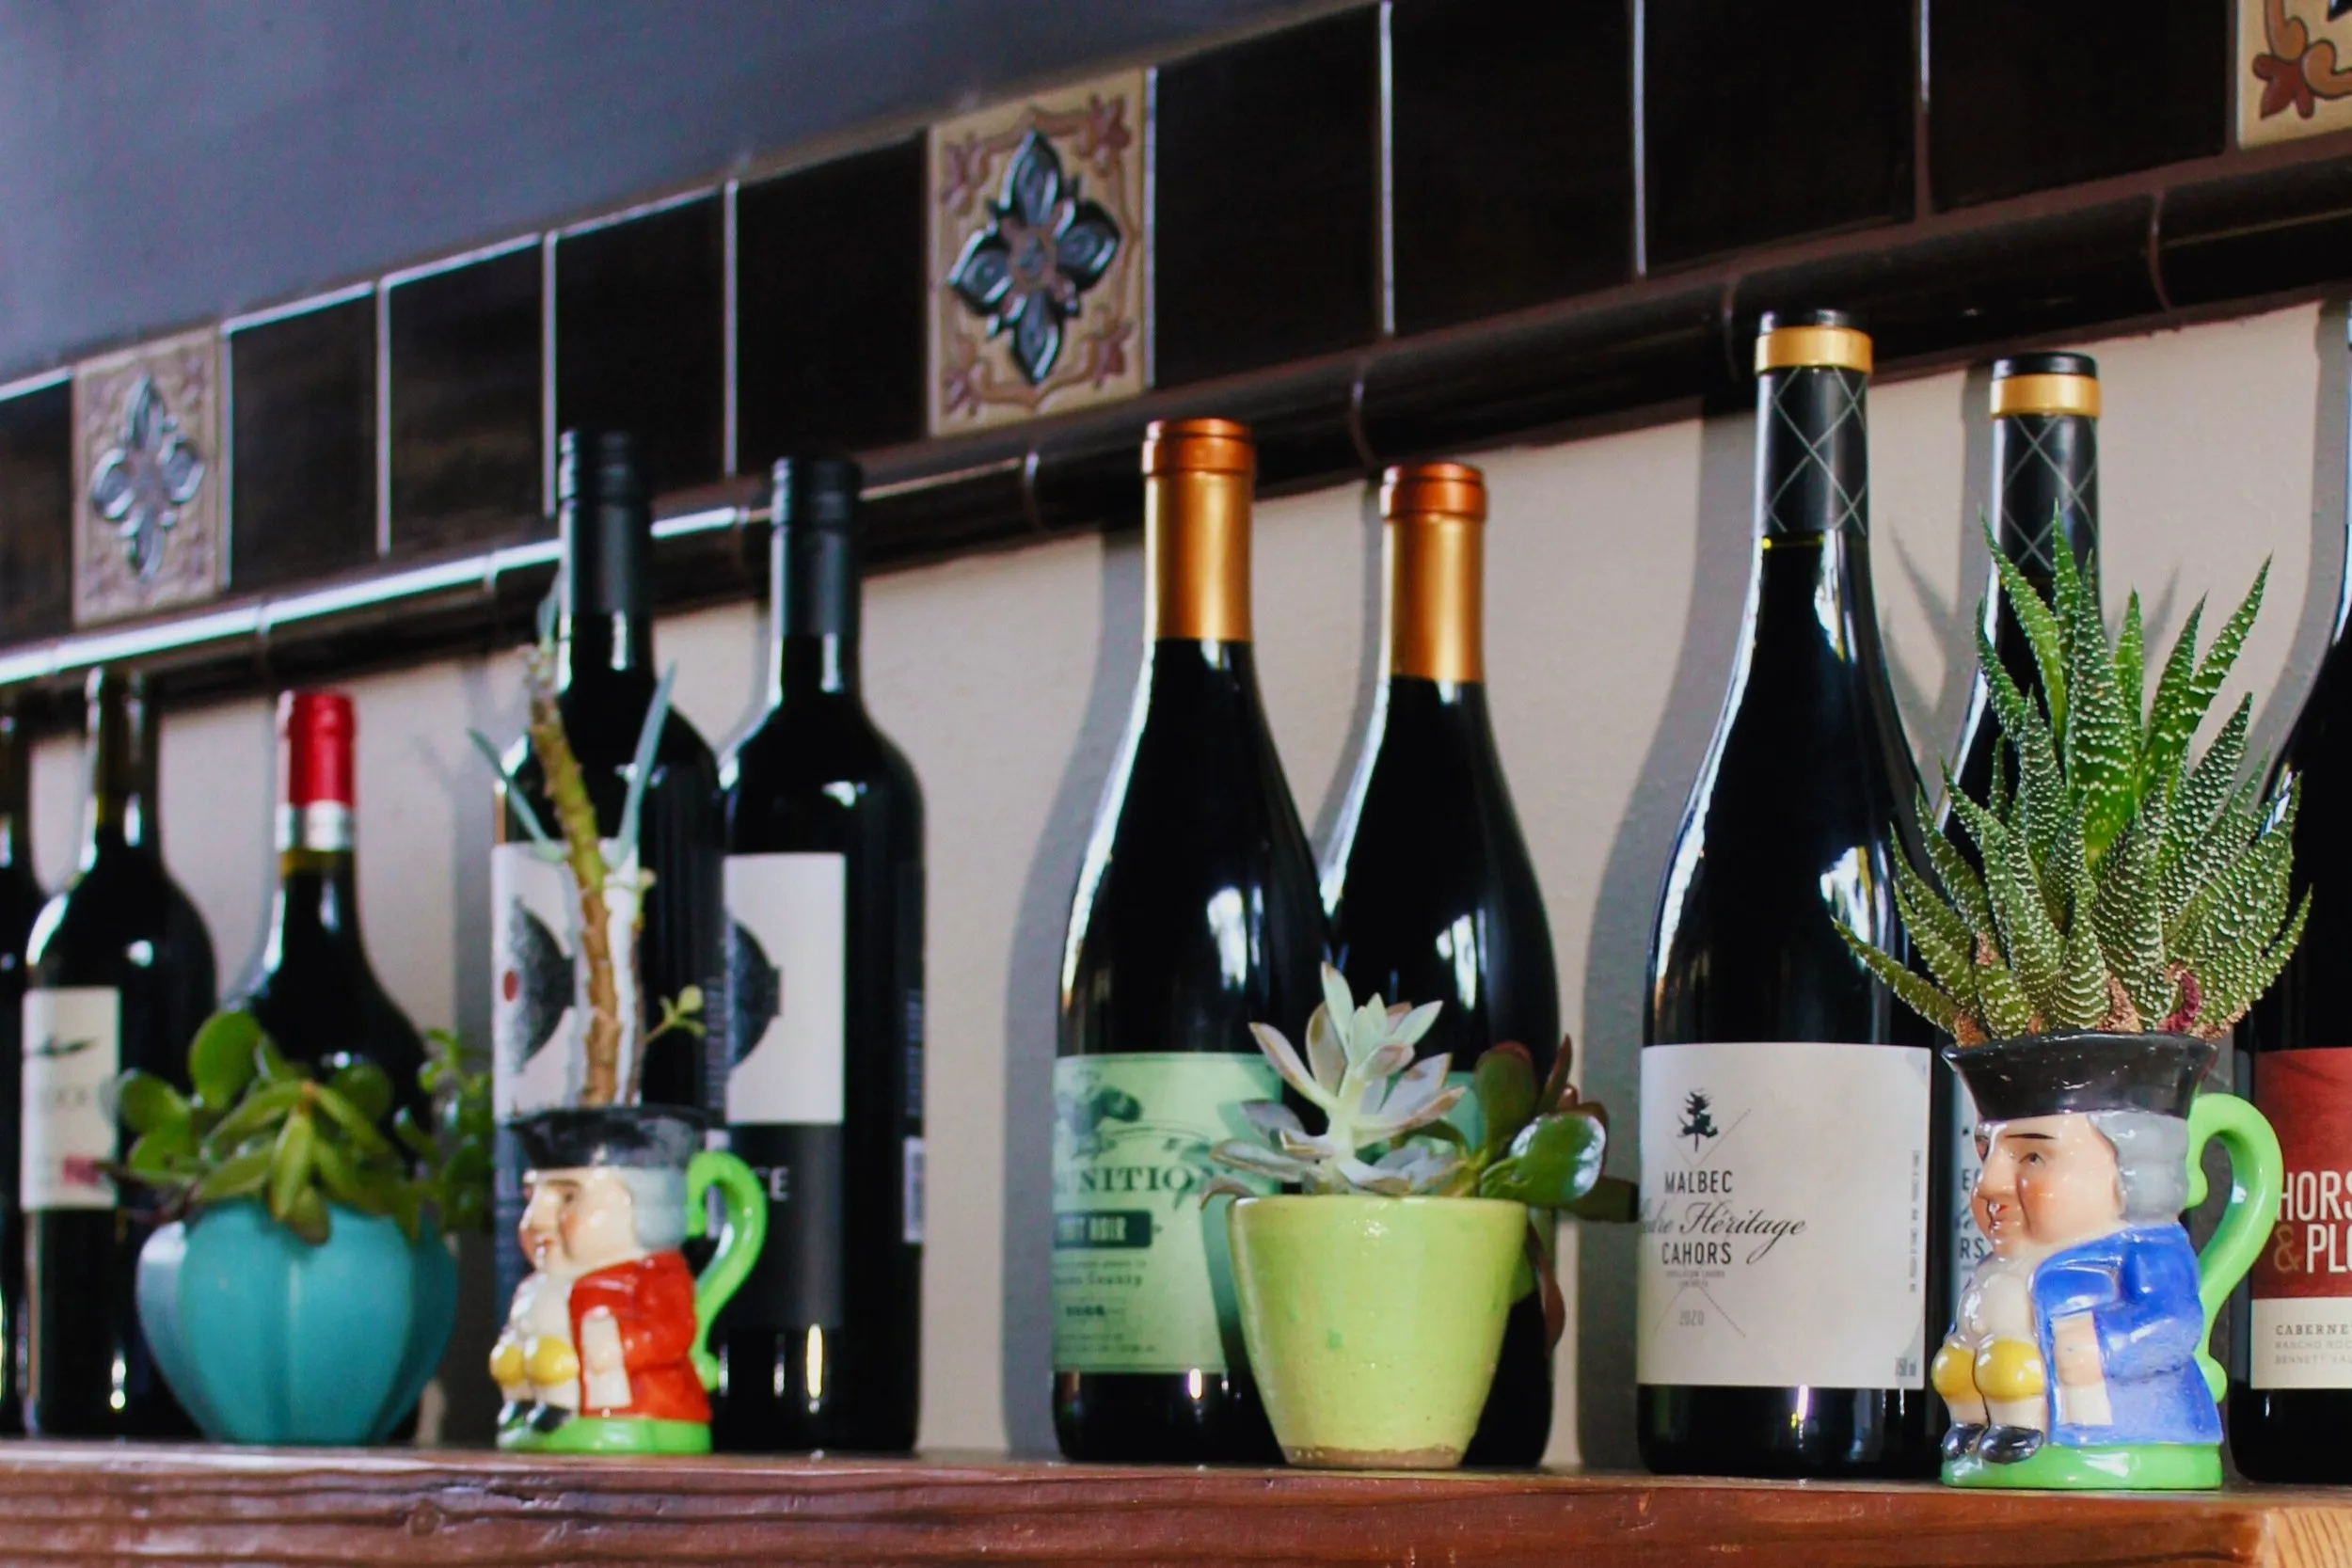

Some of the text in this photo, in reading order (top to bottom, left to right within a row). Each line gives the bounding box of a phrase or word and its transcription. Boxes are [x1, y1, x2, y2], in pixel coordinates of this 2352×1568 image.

[1663, 1170, 1733, 1194] MALBEC
[1679, 1199, 1807, 1265] Héritage
[1661, 1242, 1732, 1265] CAHORS
[2275, 1323, 2352, 1336] CABERNE
